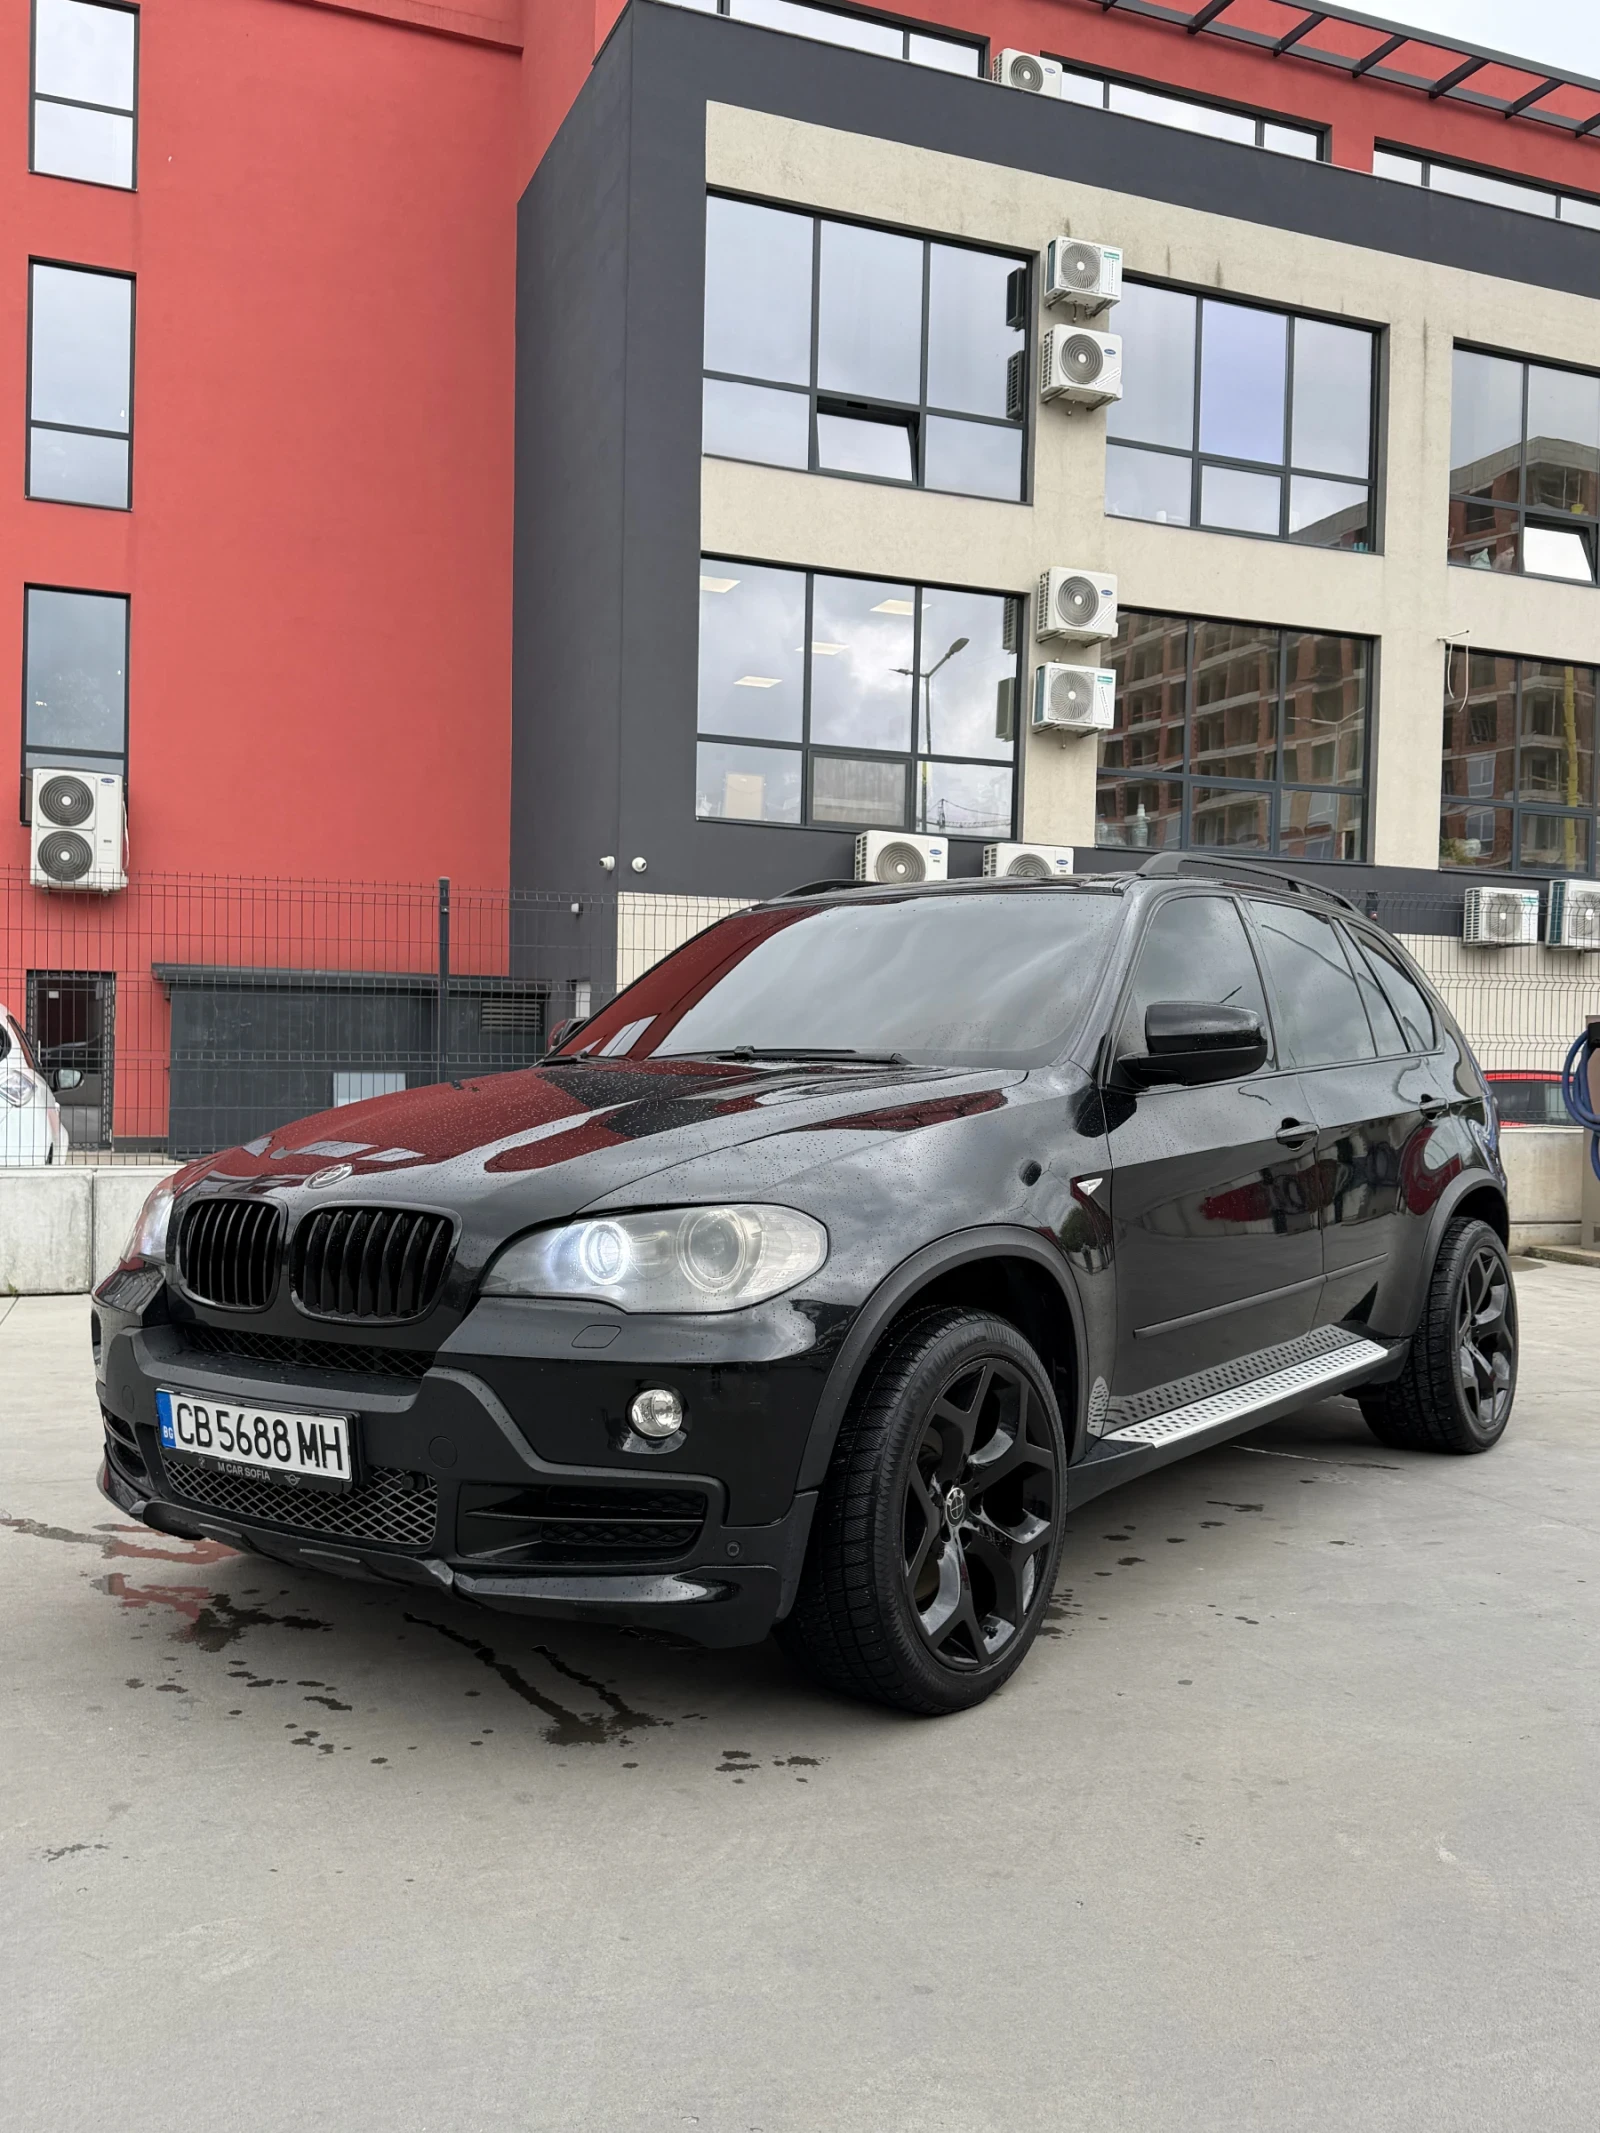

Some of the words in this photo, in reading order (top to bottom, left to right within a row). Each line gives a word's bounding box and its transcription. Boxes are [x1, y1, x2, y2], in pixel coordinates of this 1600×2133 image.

[163, 1425, 173, 1439] BG
[216, 1410, 291, 1462] 5688
[297, 1421, 343, 1471] MH
[217, 1461, 225, 1472] M
[226, 1463, 243, 1476] CAR
[244, 1467, 270, 1480] SOFIA
